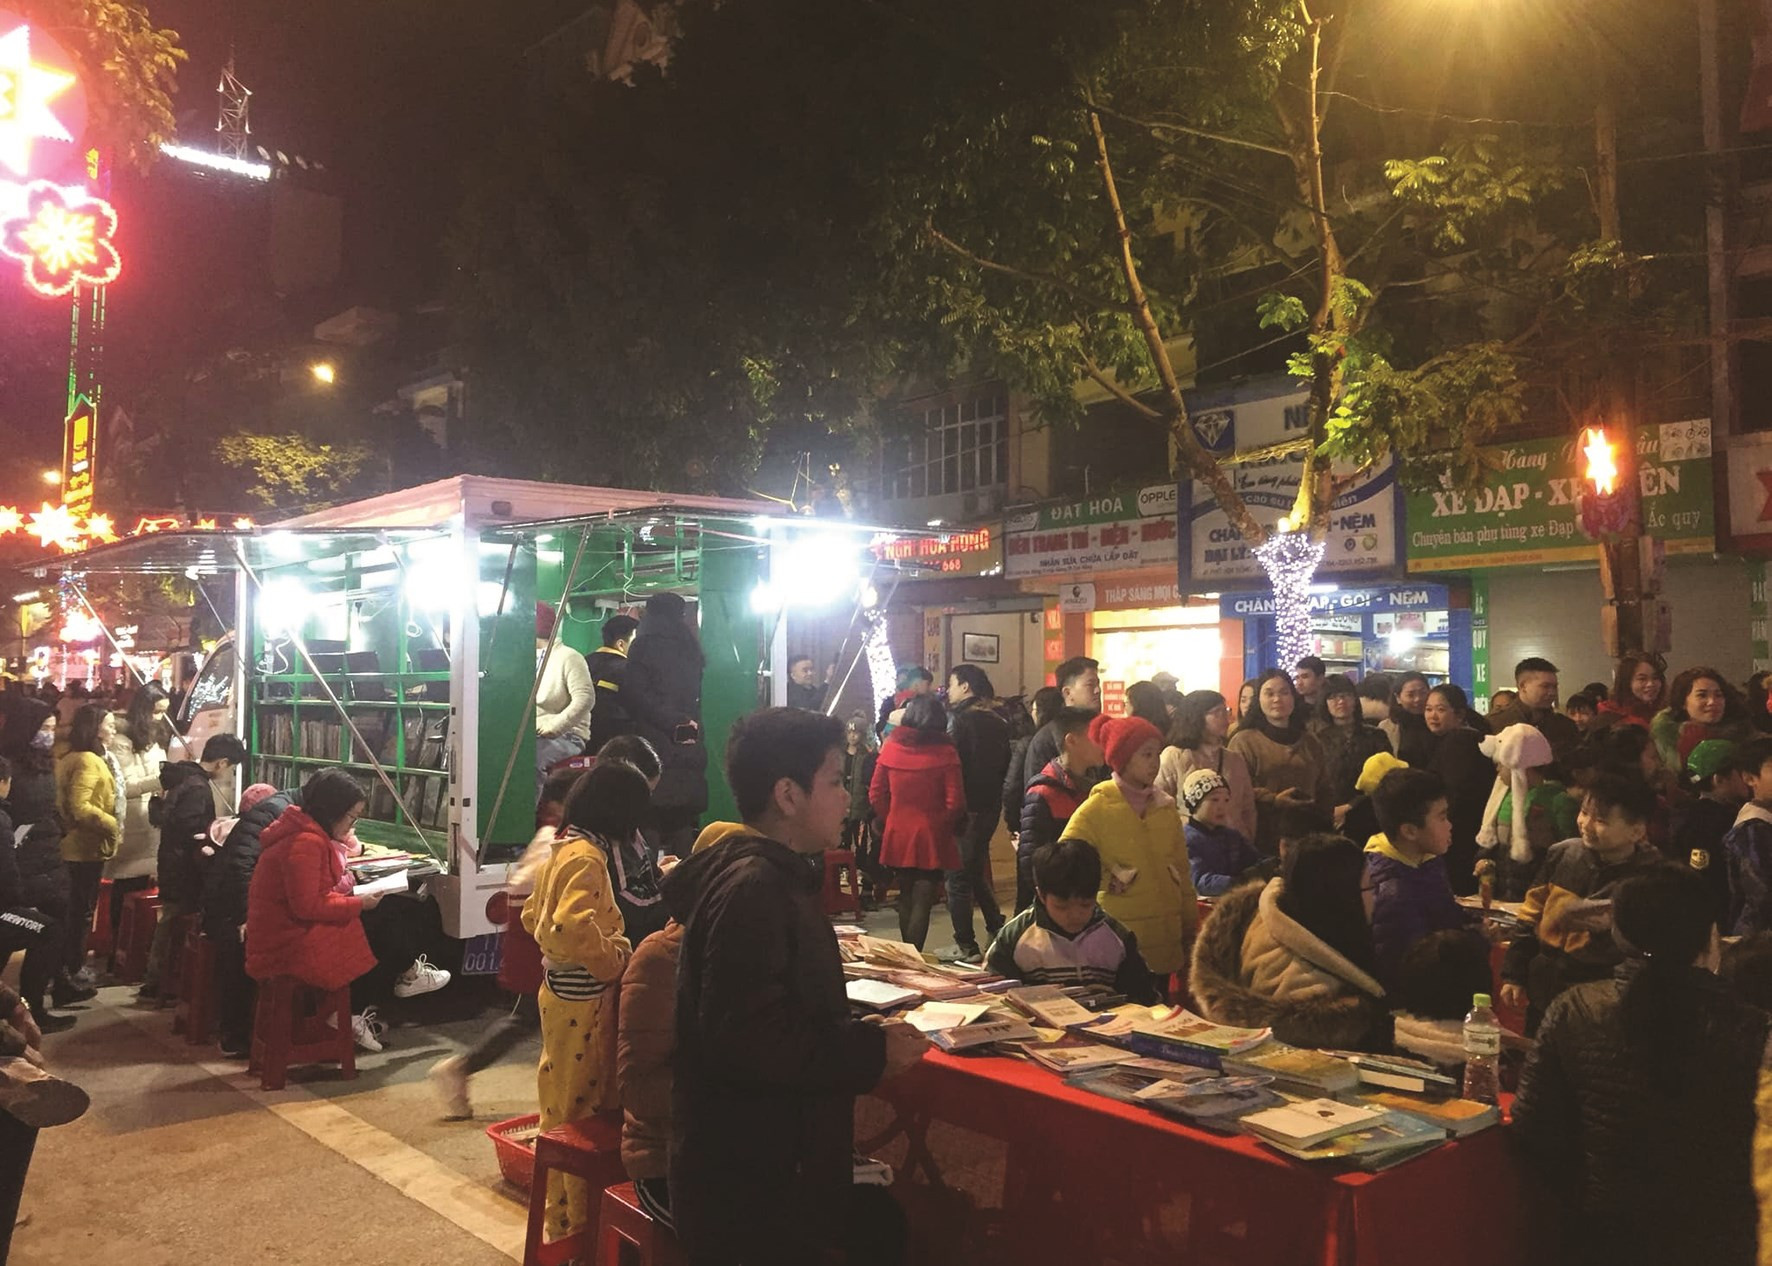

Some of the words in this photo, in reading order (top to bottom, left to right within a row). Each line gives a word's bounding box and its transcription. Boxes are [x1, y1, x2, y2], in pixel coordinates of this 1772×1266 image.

[1140, 489, 1177, 505] OPPLE
[1473, 483, 1530, 517] ĐẠP
[1051, 503, 1083, 525] ĐẠT
[1339, 512, 1376, 535] NỆM
[1412, 529, 1451, 549] Chuyên
[1530, 525, 1545, 538] xe
[1549, 519, 1575, 538] Đạp
[1671, 511, 1701, 531] quy
[1389, 590, 1429, 609] NỆM
